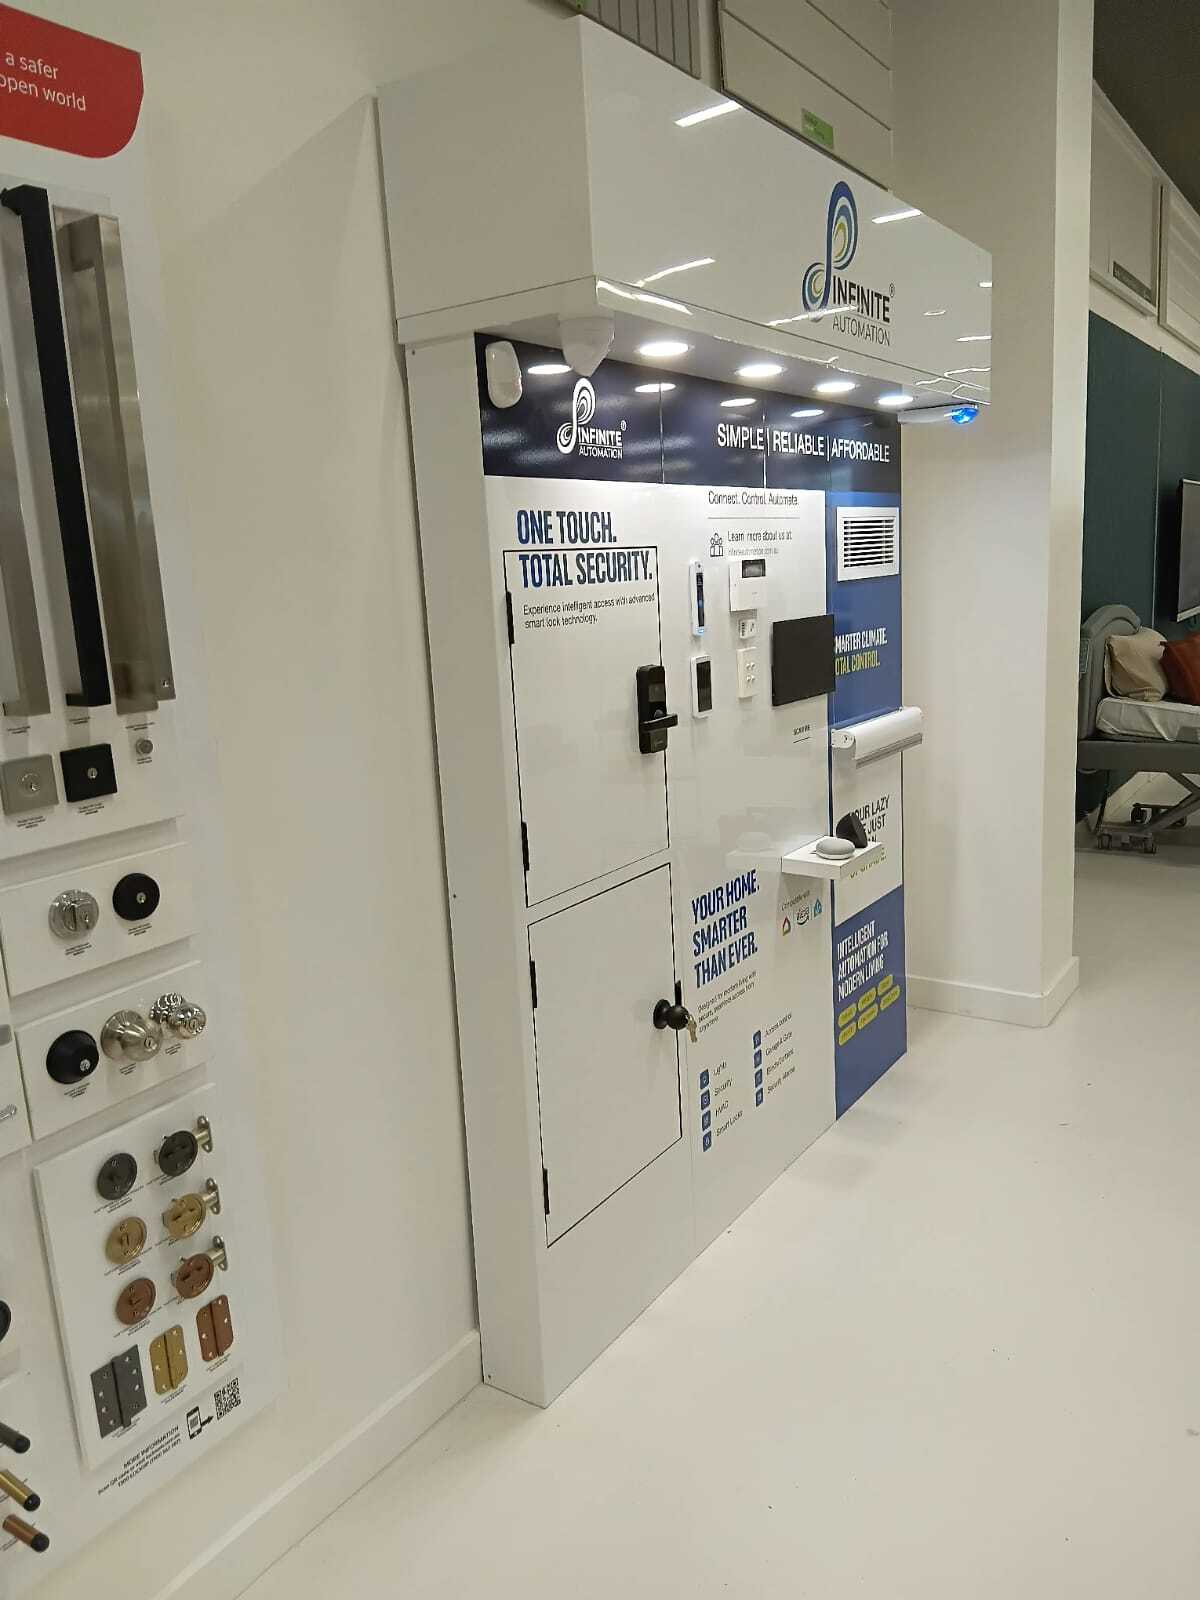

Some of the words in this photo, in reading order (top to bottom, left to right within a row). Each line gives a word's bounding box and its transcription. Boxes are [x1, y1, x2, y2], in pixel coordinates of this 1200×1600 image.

[6, 52, 15, 66] a
[20, 55, 59, 79] safer
[43, 87, 86, 111] world
[832, 275, 890, 324] INFINITE
[832, 315, 890, 347] AUTOMATION
[578, 427, 622, 446] INFINITE
[717, 423, 765, 450] SIMPLE
[773, 430, 825, 457] RELIABLE
[831, 438, 890, 463] AFFORDABLE
[579, 446, 622, 460] AUTOMATION
[517, 509, 554, 544] ONE
[556, 510, 617, 544] TOUCH.
[518, 552, 573, 588] TOTAL
[576, 550, 653, 584] SECURITY.
[523, 602, 561, 616] Experience
[594, 597, 614, 609] access
[524, 616, 545, 629] smart
[546, 615, 561, 628] lock
[834, 631, 861, 654] MARTER
[861, 627, 888, 649] CLIMATE.
[834, 655, 851, 676] OTAL
[851, 649, 881, 672] CONTROL.
[871, 794, 891, 817] LAZY
[867, 813, 887, 835] JUST
[691, 885, 724, 925] YOUR
[726, 868, 760, 908] HOME.
[692, 905, 748, 958] SMARTER
[837, 920, 876, 961] INTELLIGENT
[693, 953, 727, 989] THAN
[728, 931, 758, 970] EVER.
[838, 941, 877, 981] AUTOMATION
[876, 930, 889, 952] FOR
[838, 967, 865, 1002] MODERN
[865, 953, 885, 981] LIVING
[123, 1453, 141, 1469] MORE
